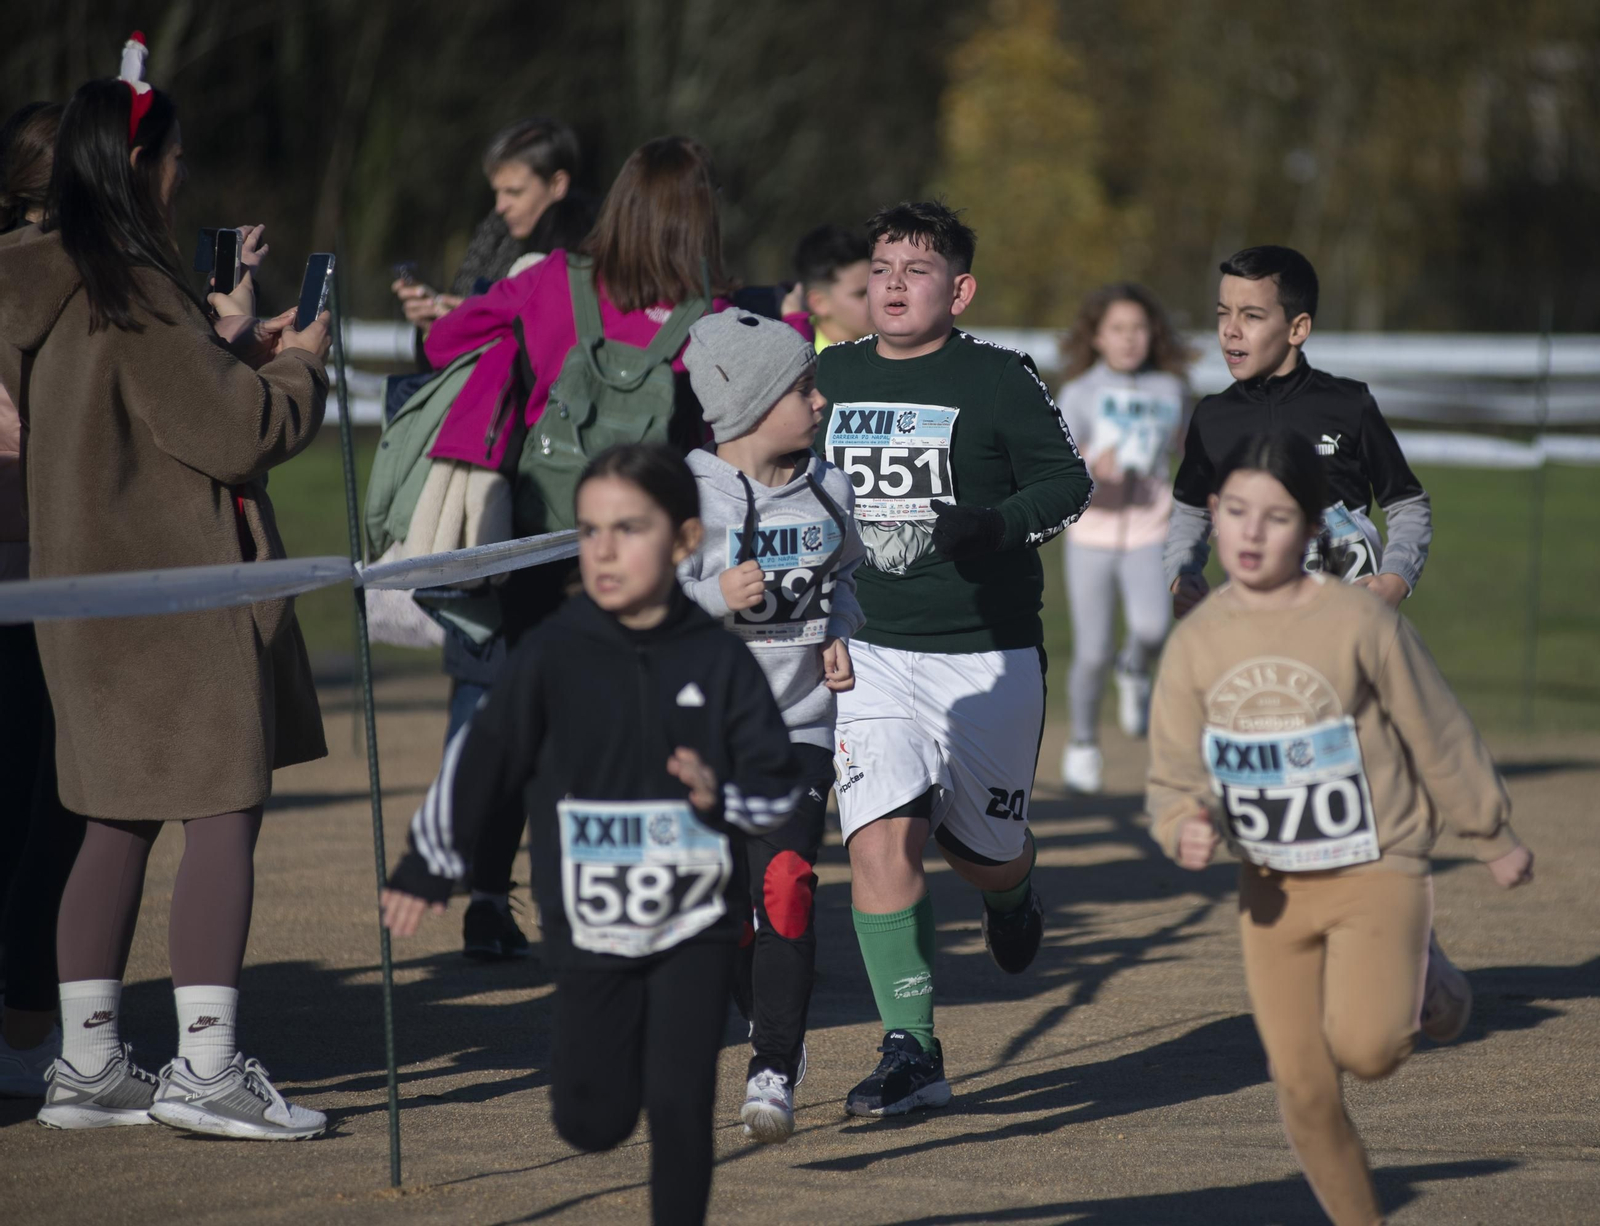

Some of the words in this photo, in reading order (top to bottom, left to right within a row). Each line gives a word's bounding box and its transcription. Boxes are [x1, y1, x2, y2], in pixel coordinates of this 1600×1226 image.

[834, 410, 895, 434] XXII
[1315, 444, 1335, 455] MA
[843, 448, 942, 496] 551
[1214, 740, 1281, 772] XXII
[985, 787, 1025, 820] 20
[1227, 778, 1362, 843] 570
[571, 814, 642, 847] XXII
[578, 865, 721, 926] 587
[91, 1011, 114, 1020] NIKE
[195, 1016, 220, 1025] NIKE
